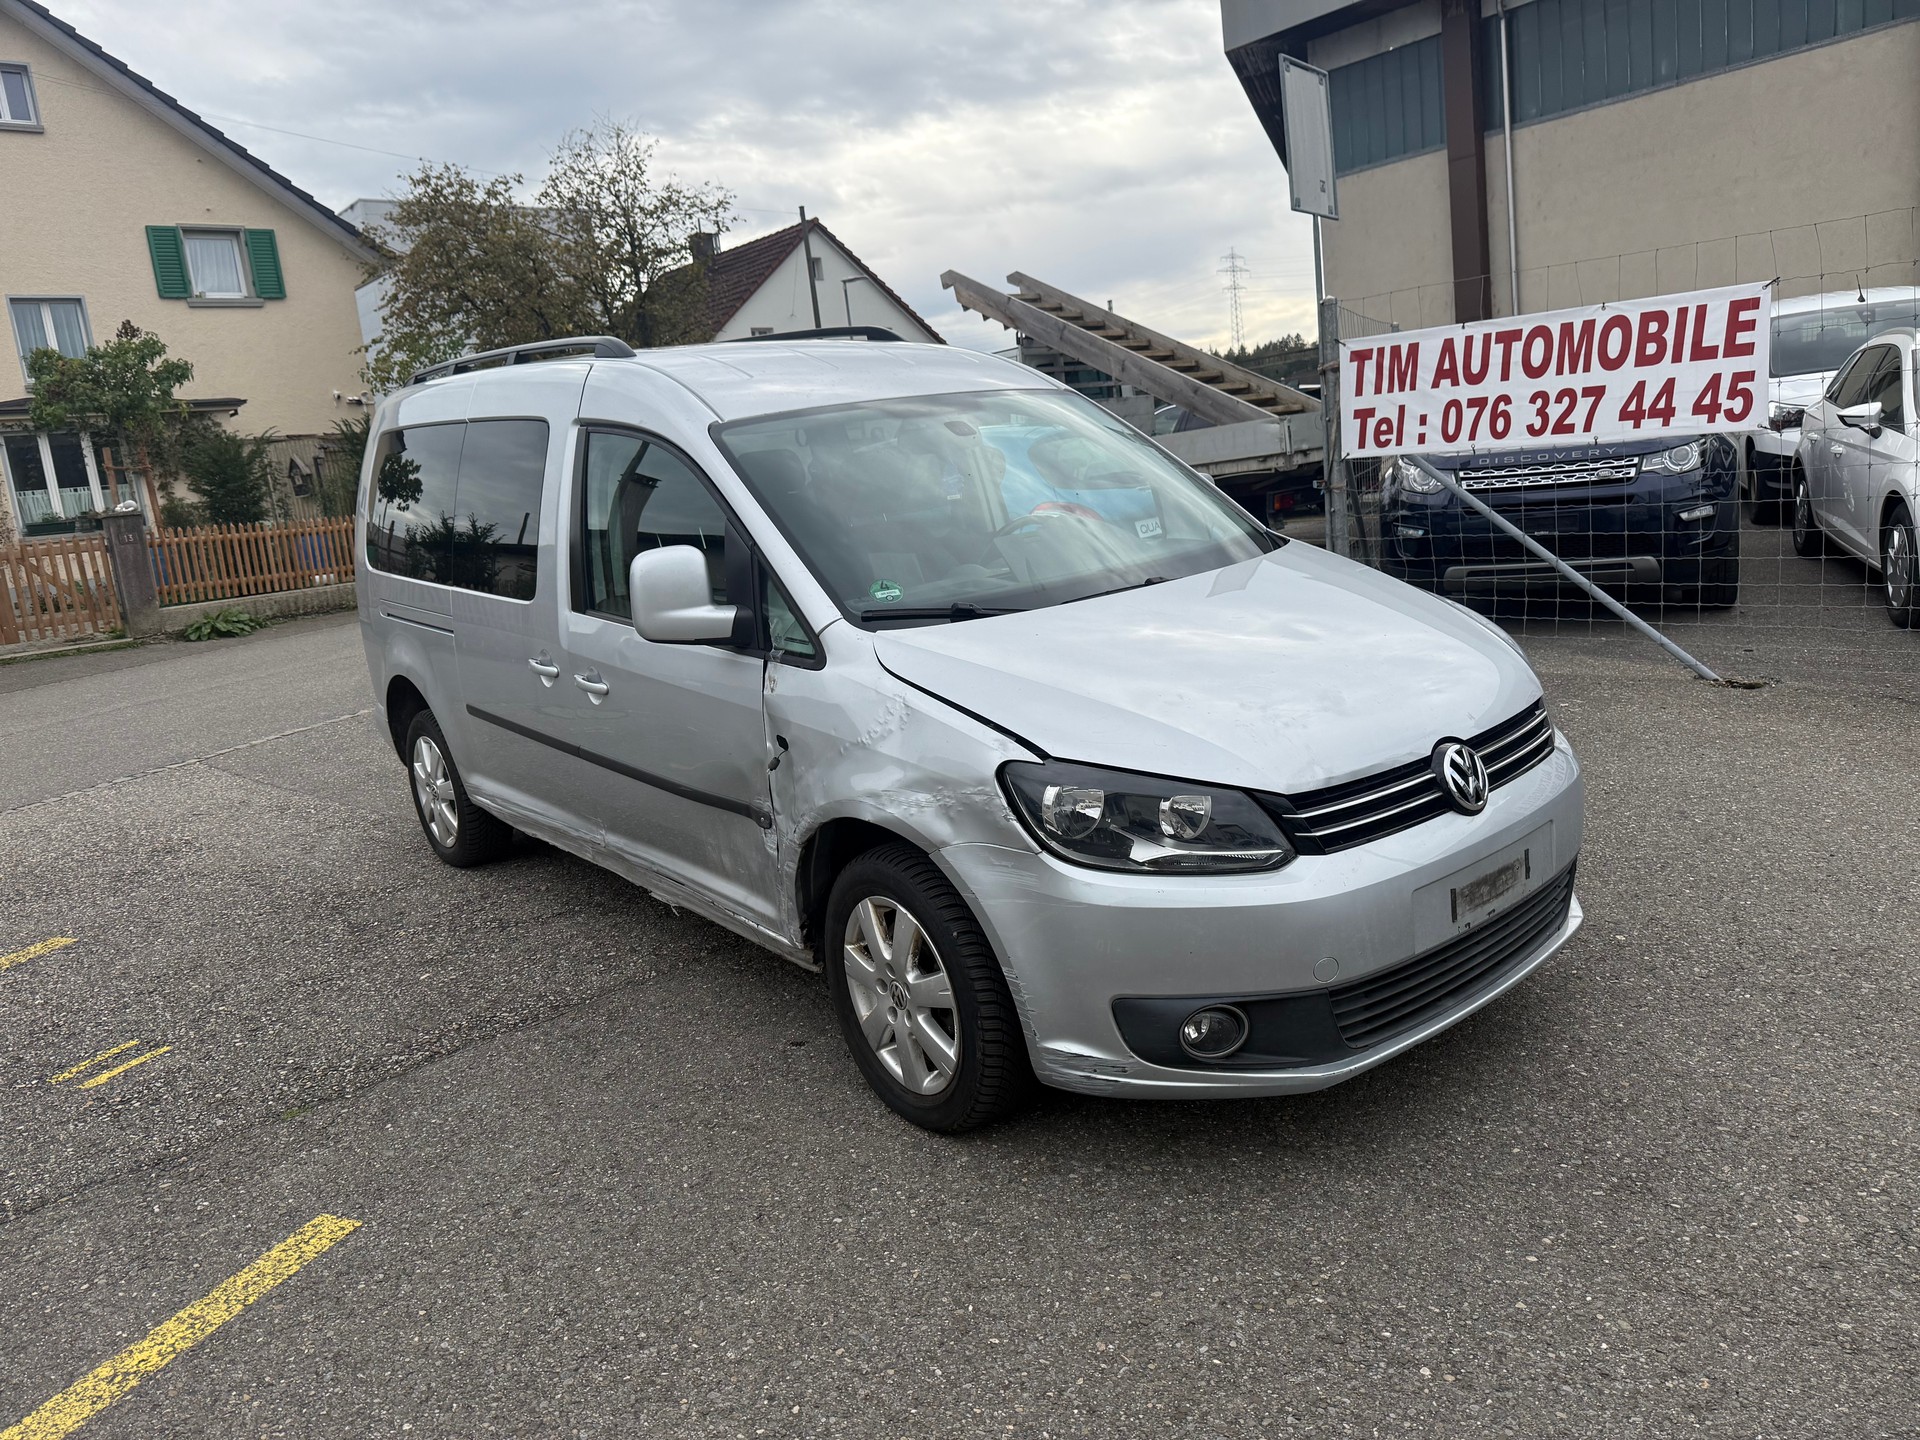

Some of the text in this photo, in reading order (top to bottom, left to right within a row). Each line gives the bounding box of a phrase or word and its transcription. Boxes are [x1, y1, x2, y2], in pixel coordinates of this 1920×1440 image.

[1350, 297, 1761, 396] TIM AUTOMOBILE
[1353, 404, 1405, 449] Tel
[1441, 394, 1512, 443] 076
[1526, 385, 1606, 437] 327
[1618, 377, 1676, 429] 44
[1692, 371, 1756, 424] 45
[1479, 447, 1617, 465] DISCOVERY
[124, 534, 134, 542] 13
[880, 580, 890, 590] 4
[1443, 743, 1489, 811] VW
